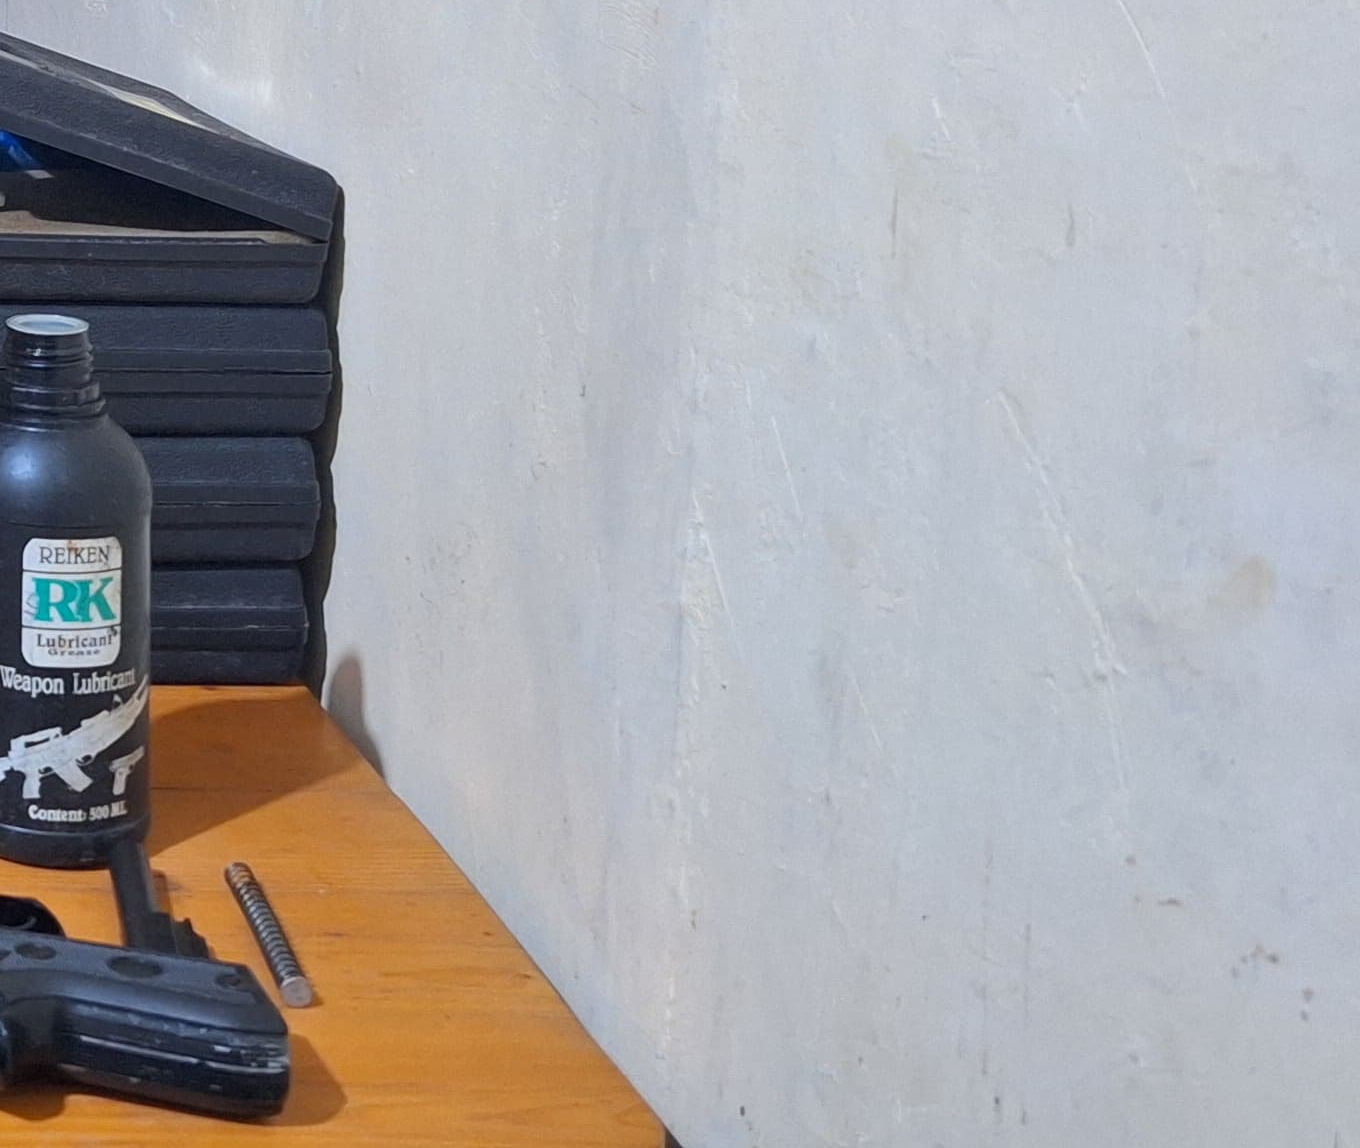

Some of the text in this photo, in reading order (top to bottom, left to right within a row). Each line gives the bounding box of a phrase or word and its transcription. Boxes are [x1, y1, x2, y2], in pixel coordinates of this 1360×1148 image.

[39, 545, 111, 565] REIKEN
[31, 576, 117, 622] RK
[36, 633, 113, 649] Lubricant
[0, 664, 137, 699] Weapon Lubricant
[88, 804, 110, 822] 500
